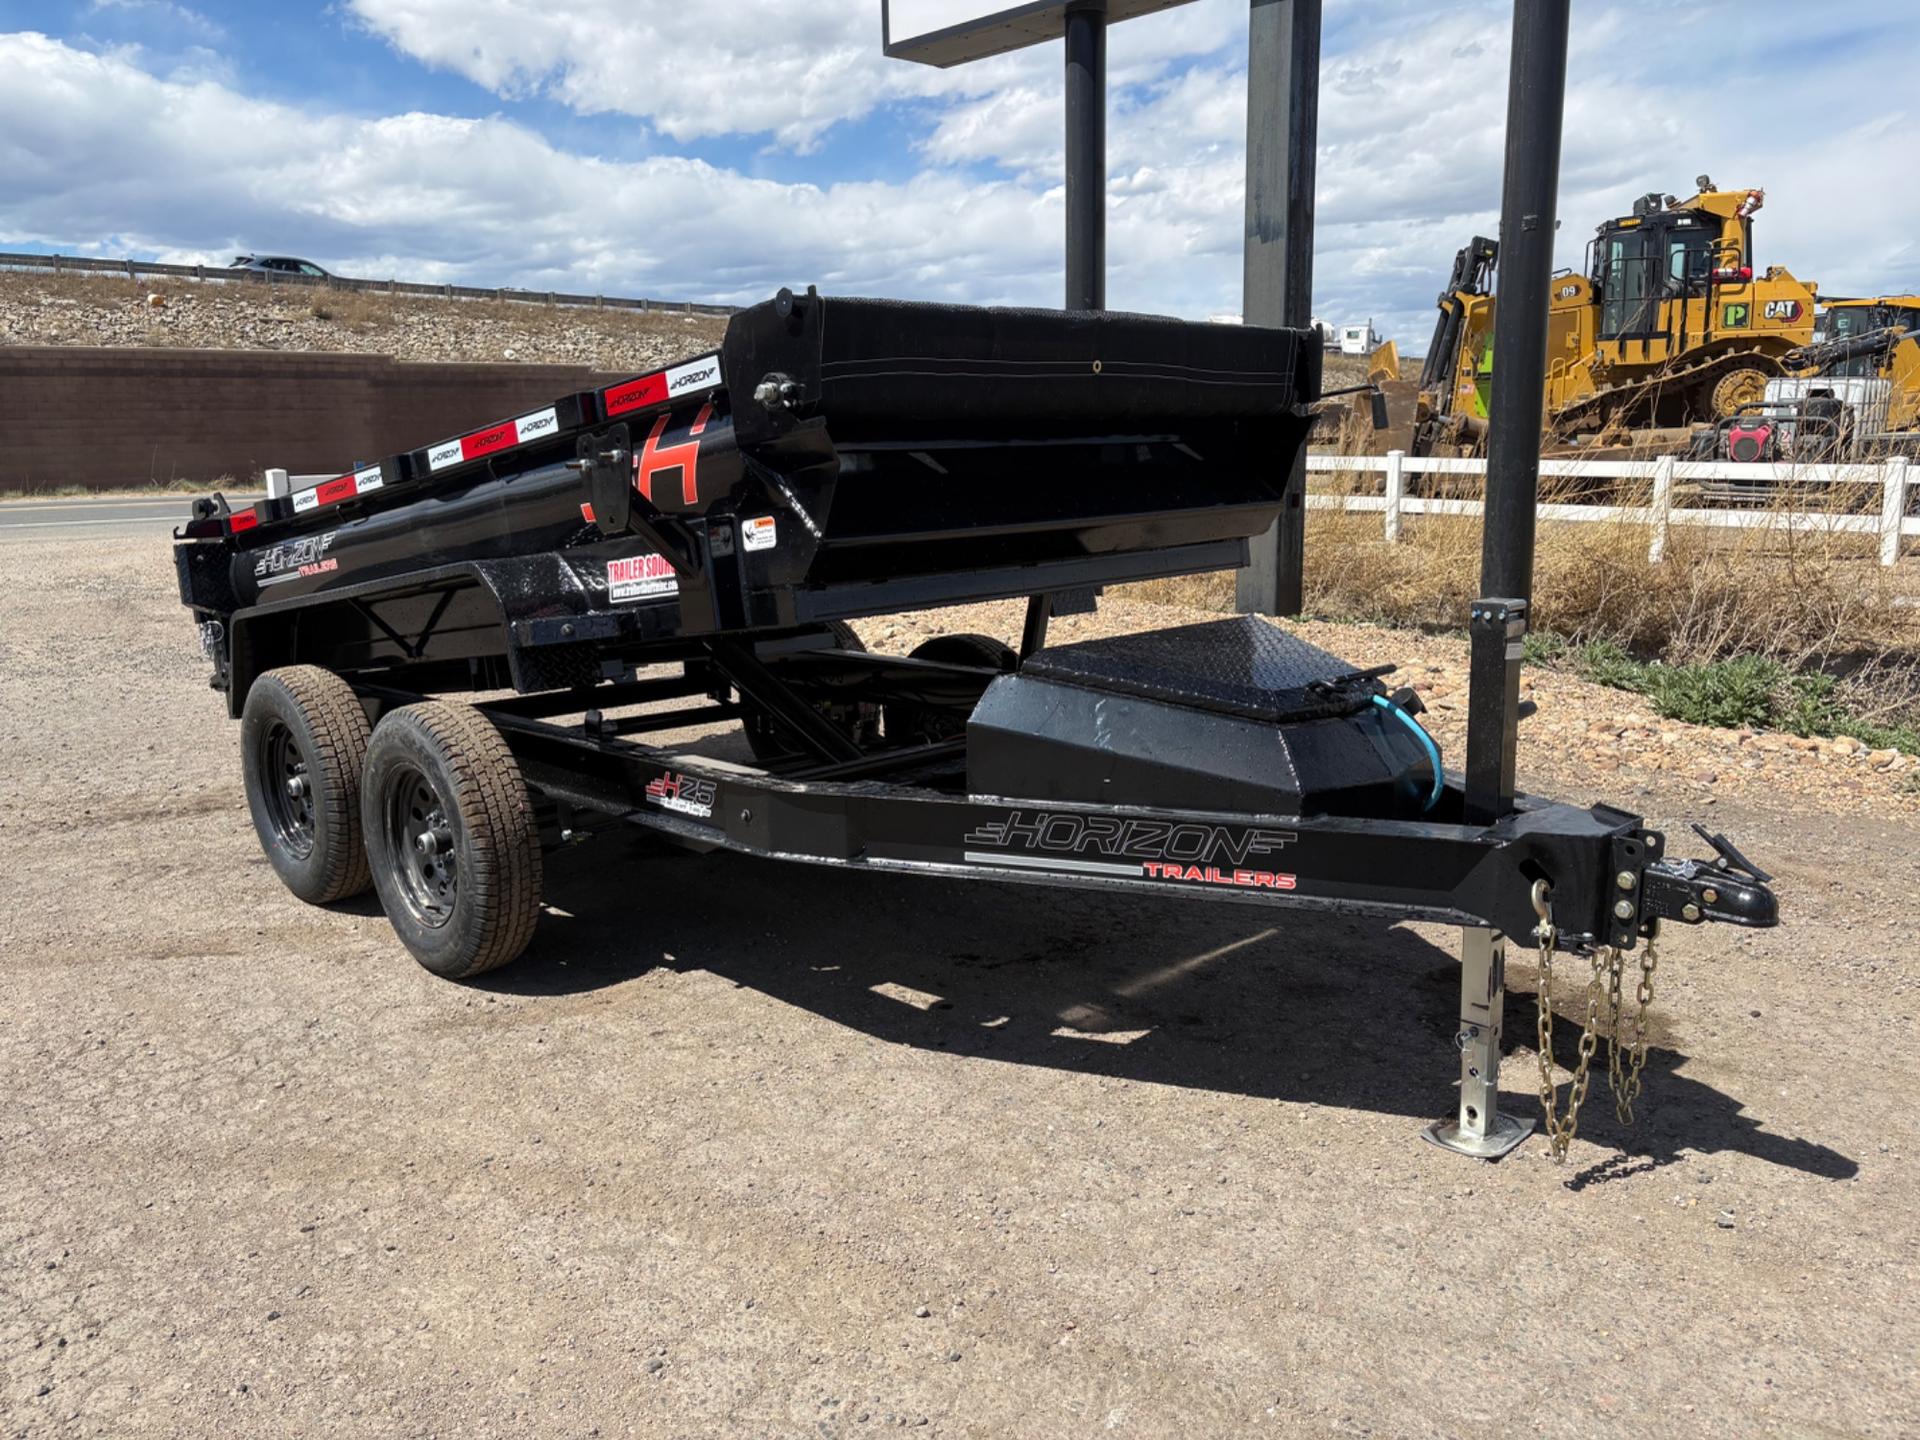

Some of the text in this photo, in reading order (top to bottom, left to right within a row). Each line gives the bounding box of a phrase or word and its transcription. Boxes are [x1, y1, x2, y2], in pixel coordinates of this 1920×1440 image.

[1561, 286, 1576, 297] D9
[1765, 301, 1795, 319] CAT
[672, 367, 715, 388] HORIZON
[609, 388, 650, 408] HORIZON
[521, 416, 554, 434] HORIZON
[608, 556, 645, 584] TRAILER
[997, 811, 1262, 864] HORIZON
[1143, 861, 1297, 889] TRAILERS
